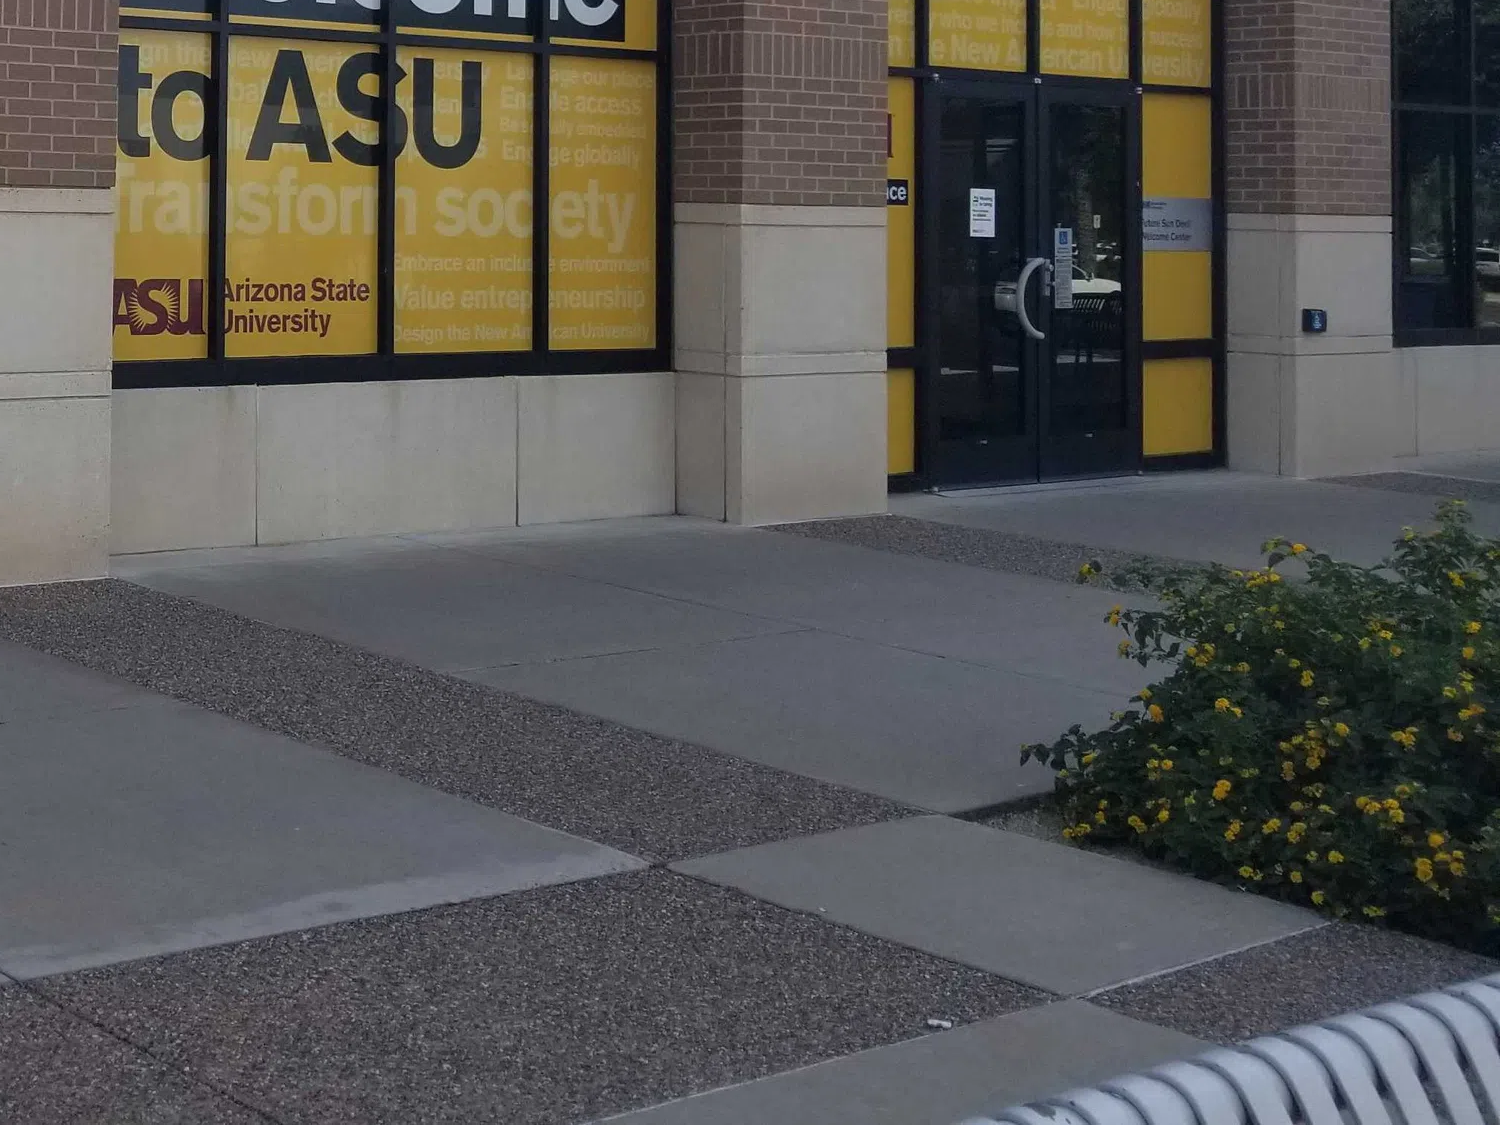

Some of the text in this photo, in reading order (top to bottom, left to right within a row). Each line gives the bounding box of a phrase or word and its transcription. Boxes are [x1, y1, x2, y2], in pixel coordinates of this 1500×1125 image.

[118, 44, 216, 162] to
[245, 49, 484, 170] ASU
[575, 95, 642, 116] access
[574, 143, 640, 171] globally
[433, 179, 636, 255] socety
[466, 257, 486, 272] an
[224, 277, 371, 303] Arizona State
[113, 279, 209, 336] ASU
[447, 324, 471, 341] the
[475, 323, 508, 341] New
